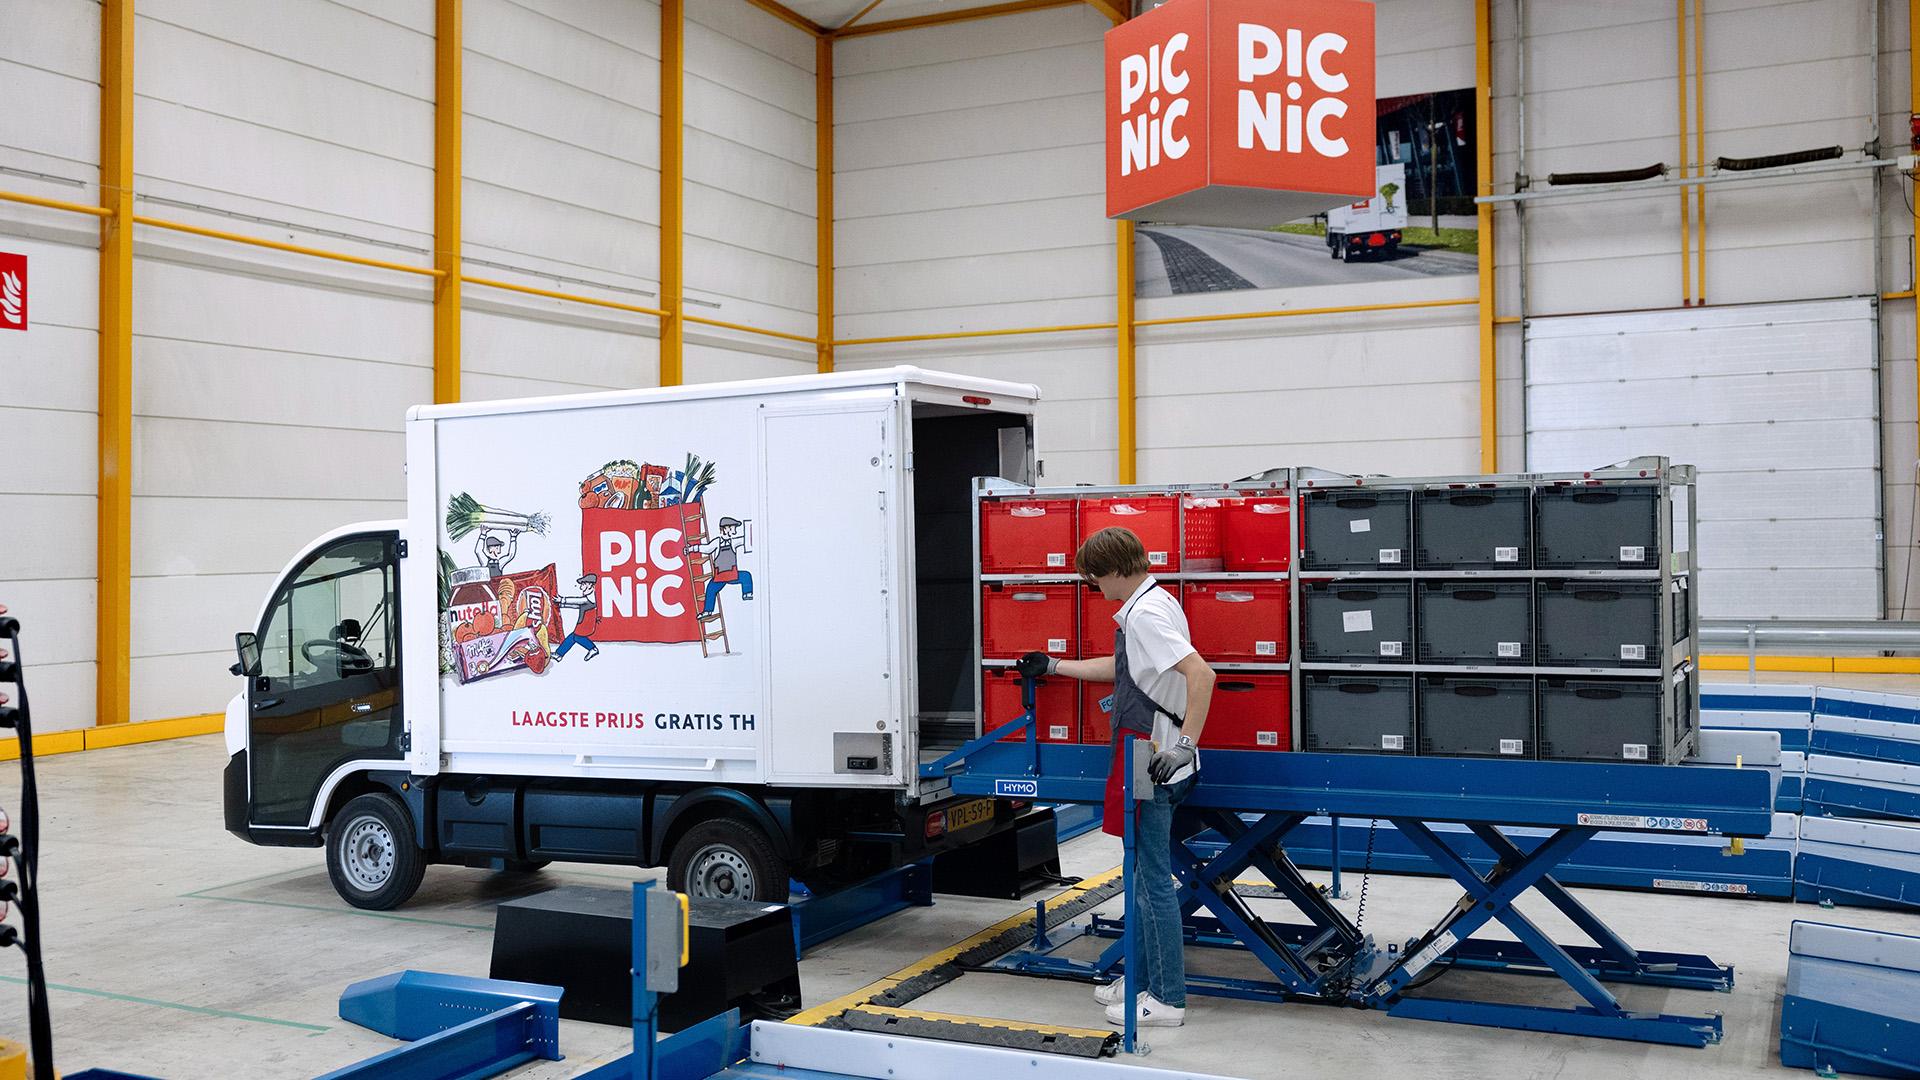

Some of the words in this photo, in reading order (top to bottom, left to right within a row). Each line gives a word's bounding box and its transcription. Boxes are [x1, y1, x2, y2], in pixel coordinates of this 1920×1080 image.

[1120, 32, 1191, 115] PIC
[1237, 22, 1350, 93] PIC
[599, 527, 684, 573] PIC
[1101, 697, 1114, 710] FC
[512, 711, 589, 728] LAAGSTE
[595, 712, 644, 730] PRIJS
[654, 713, 723, 731] GRATIS
[729, 713, 756, 731] TH
[1003, 783, 1034, 793] HYMO
